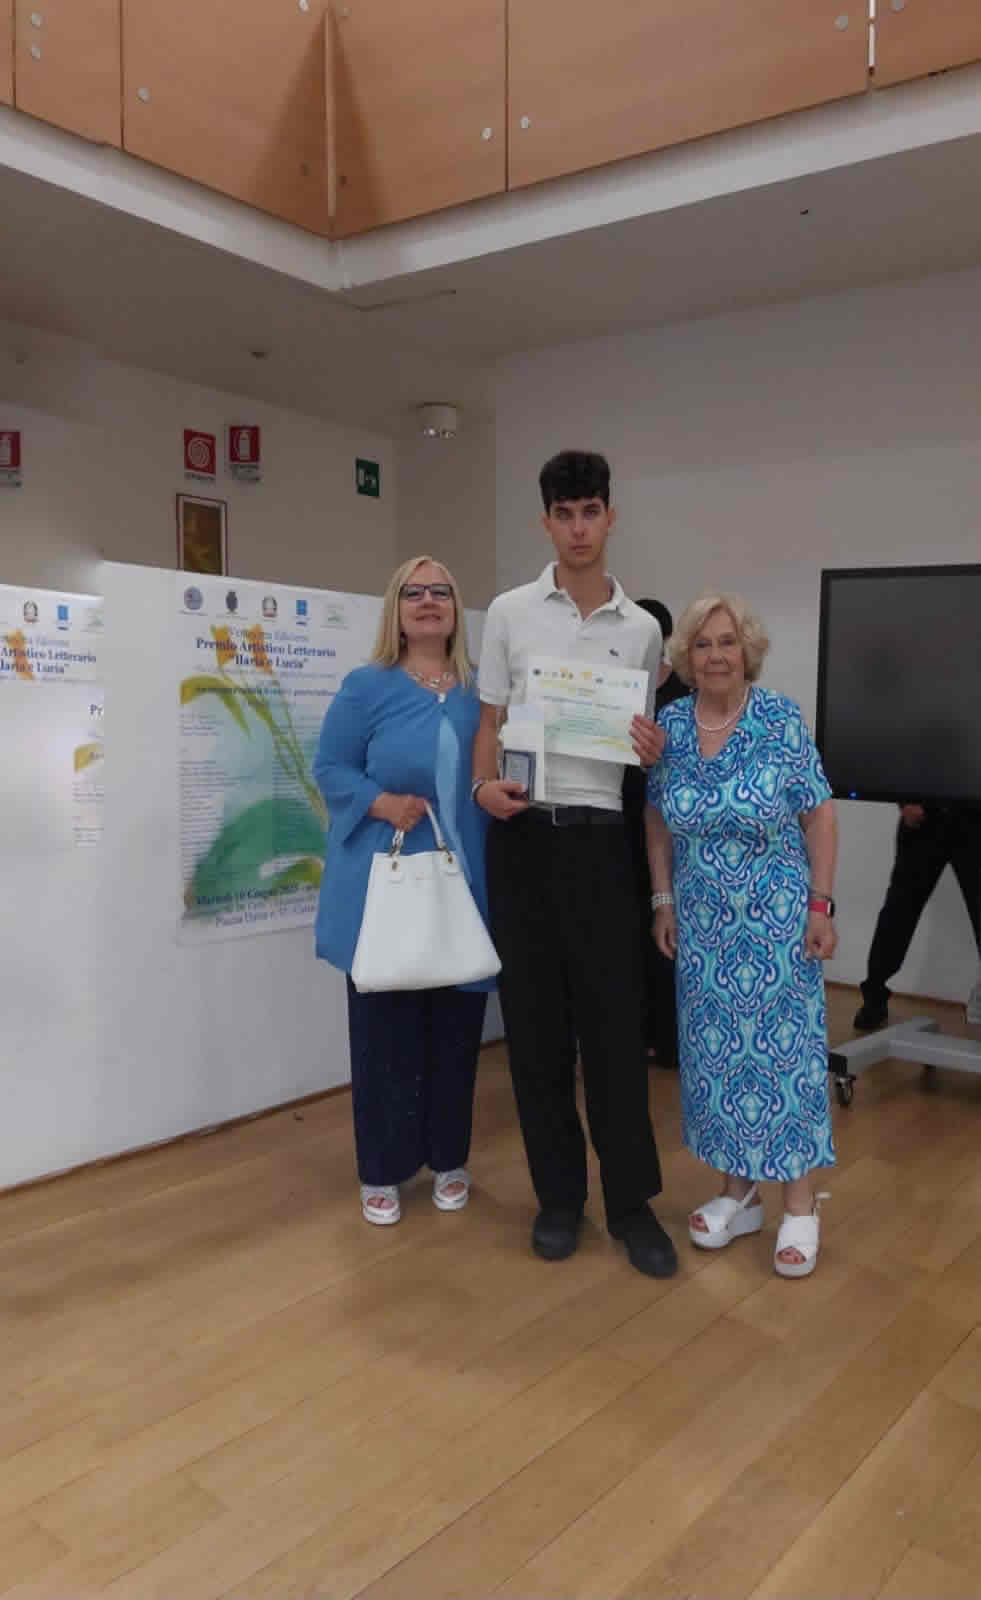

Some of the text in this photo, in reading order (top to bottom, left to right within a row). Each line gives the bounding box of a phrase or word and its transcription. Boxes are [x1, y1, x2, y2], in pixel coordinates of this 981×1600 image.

[196, 637, 337, 657] Premio Artistico Letterario
[47, 648, 97, 665] Letterario
